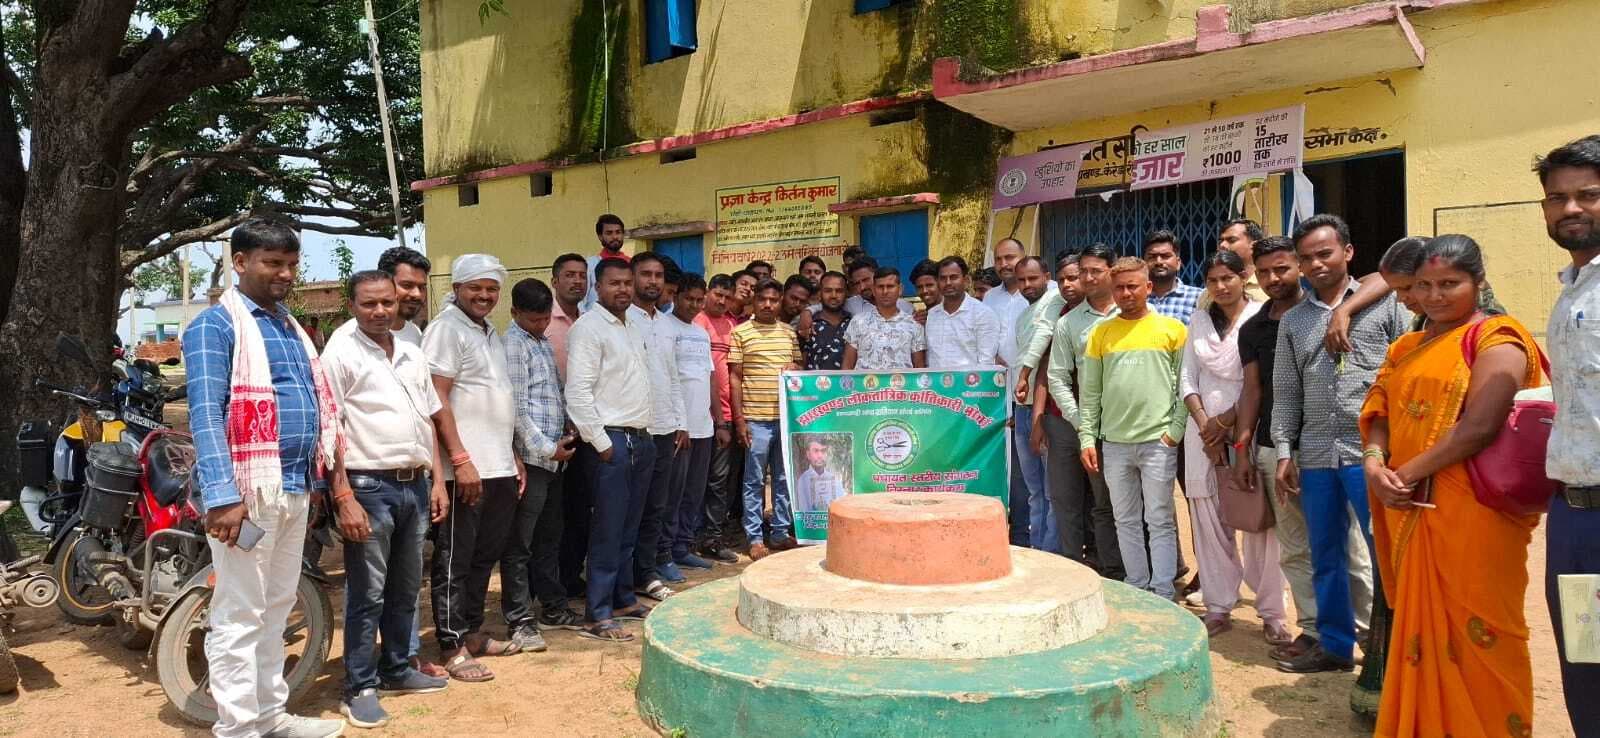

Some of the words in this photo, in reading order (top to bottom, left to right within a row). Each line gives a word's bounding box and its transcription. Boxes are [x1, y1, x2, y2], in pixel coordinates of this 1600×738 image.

[1255, 125, 1266, 136] 15
[1144, 140, 1159, 154] हर
[1160, 135, 1187, 152] साल
[1254, 133, 1289, 149] तारीख
[1303, 131, 1347, 149] सभा
[1202, 149, 1242, 168] ₹1000
[1254, 149, 1272, 161] तक
[1040, 175, 1066, 190] उपहार
[747, 190, 773, 206] केन्द्र
[807, 184, 838, 204] कुमार
